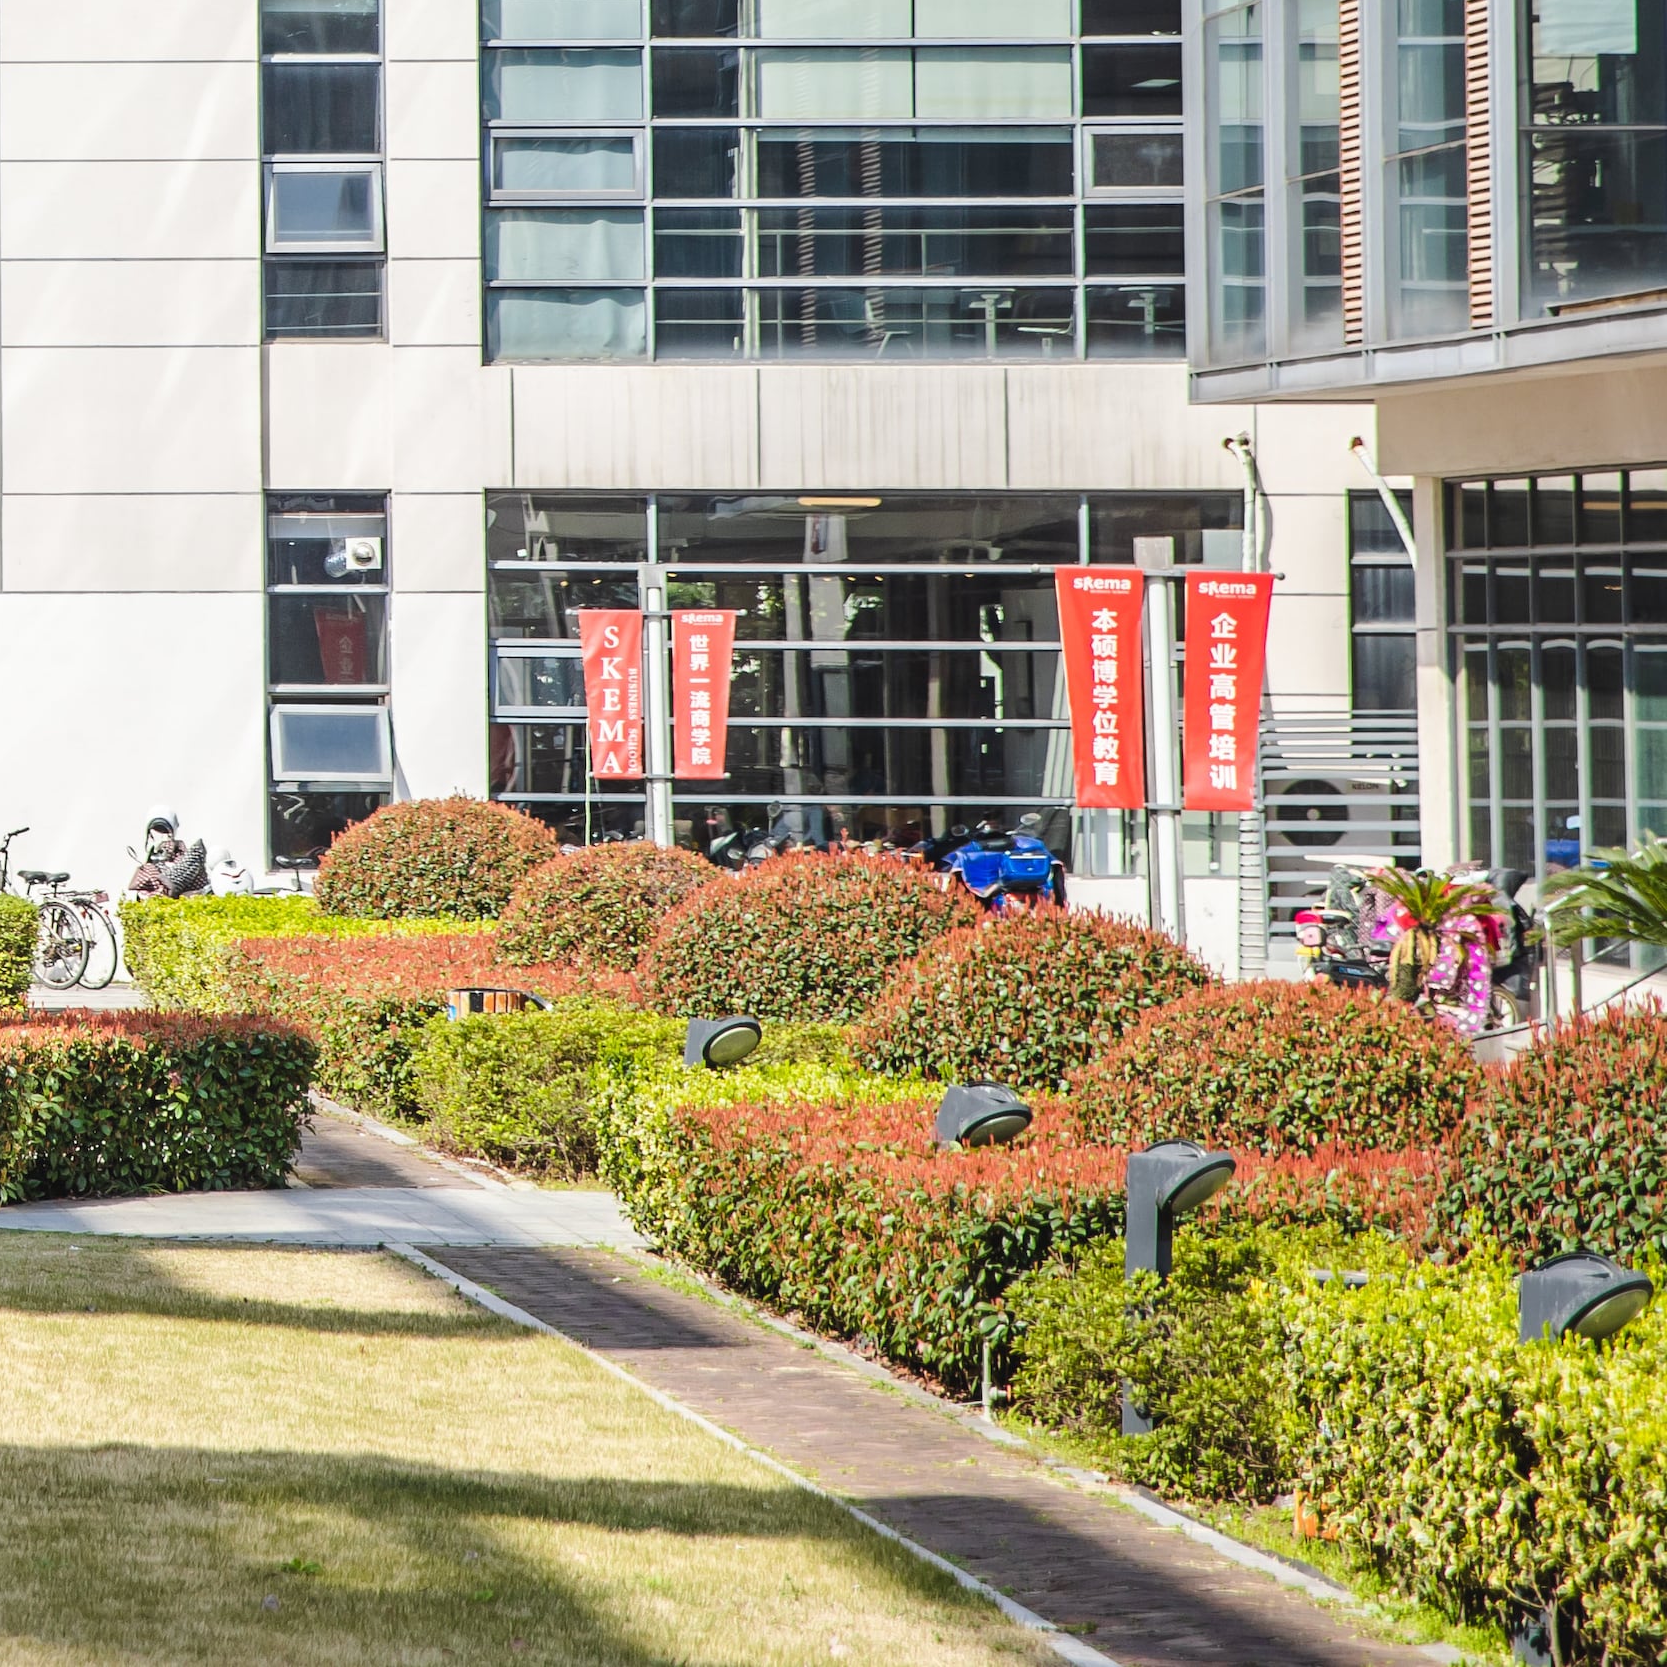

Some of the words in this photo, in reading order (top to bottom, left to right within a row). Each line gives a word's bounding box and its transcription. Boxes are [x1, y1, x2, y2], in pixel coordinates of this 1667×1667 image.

[1072, 576, 1132, 592] skema
[1198, 581, 1257, 596] skema
[596, 625, 626, 774] SKEMA
[627, 667, 639, 721] BUSINESS
[689, 634, 712, 766] 世界一流商学院
[1091, 608, 1120, 786] 本硕博学位教育
[1209, 612, 1237, 791] 企业高管培训
[628, 728, 640, 775] SCHOOL
